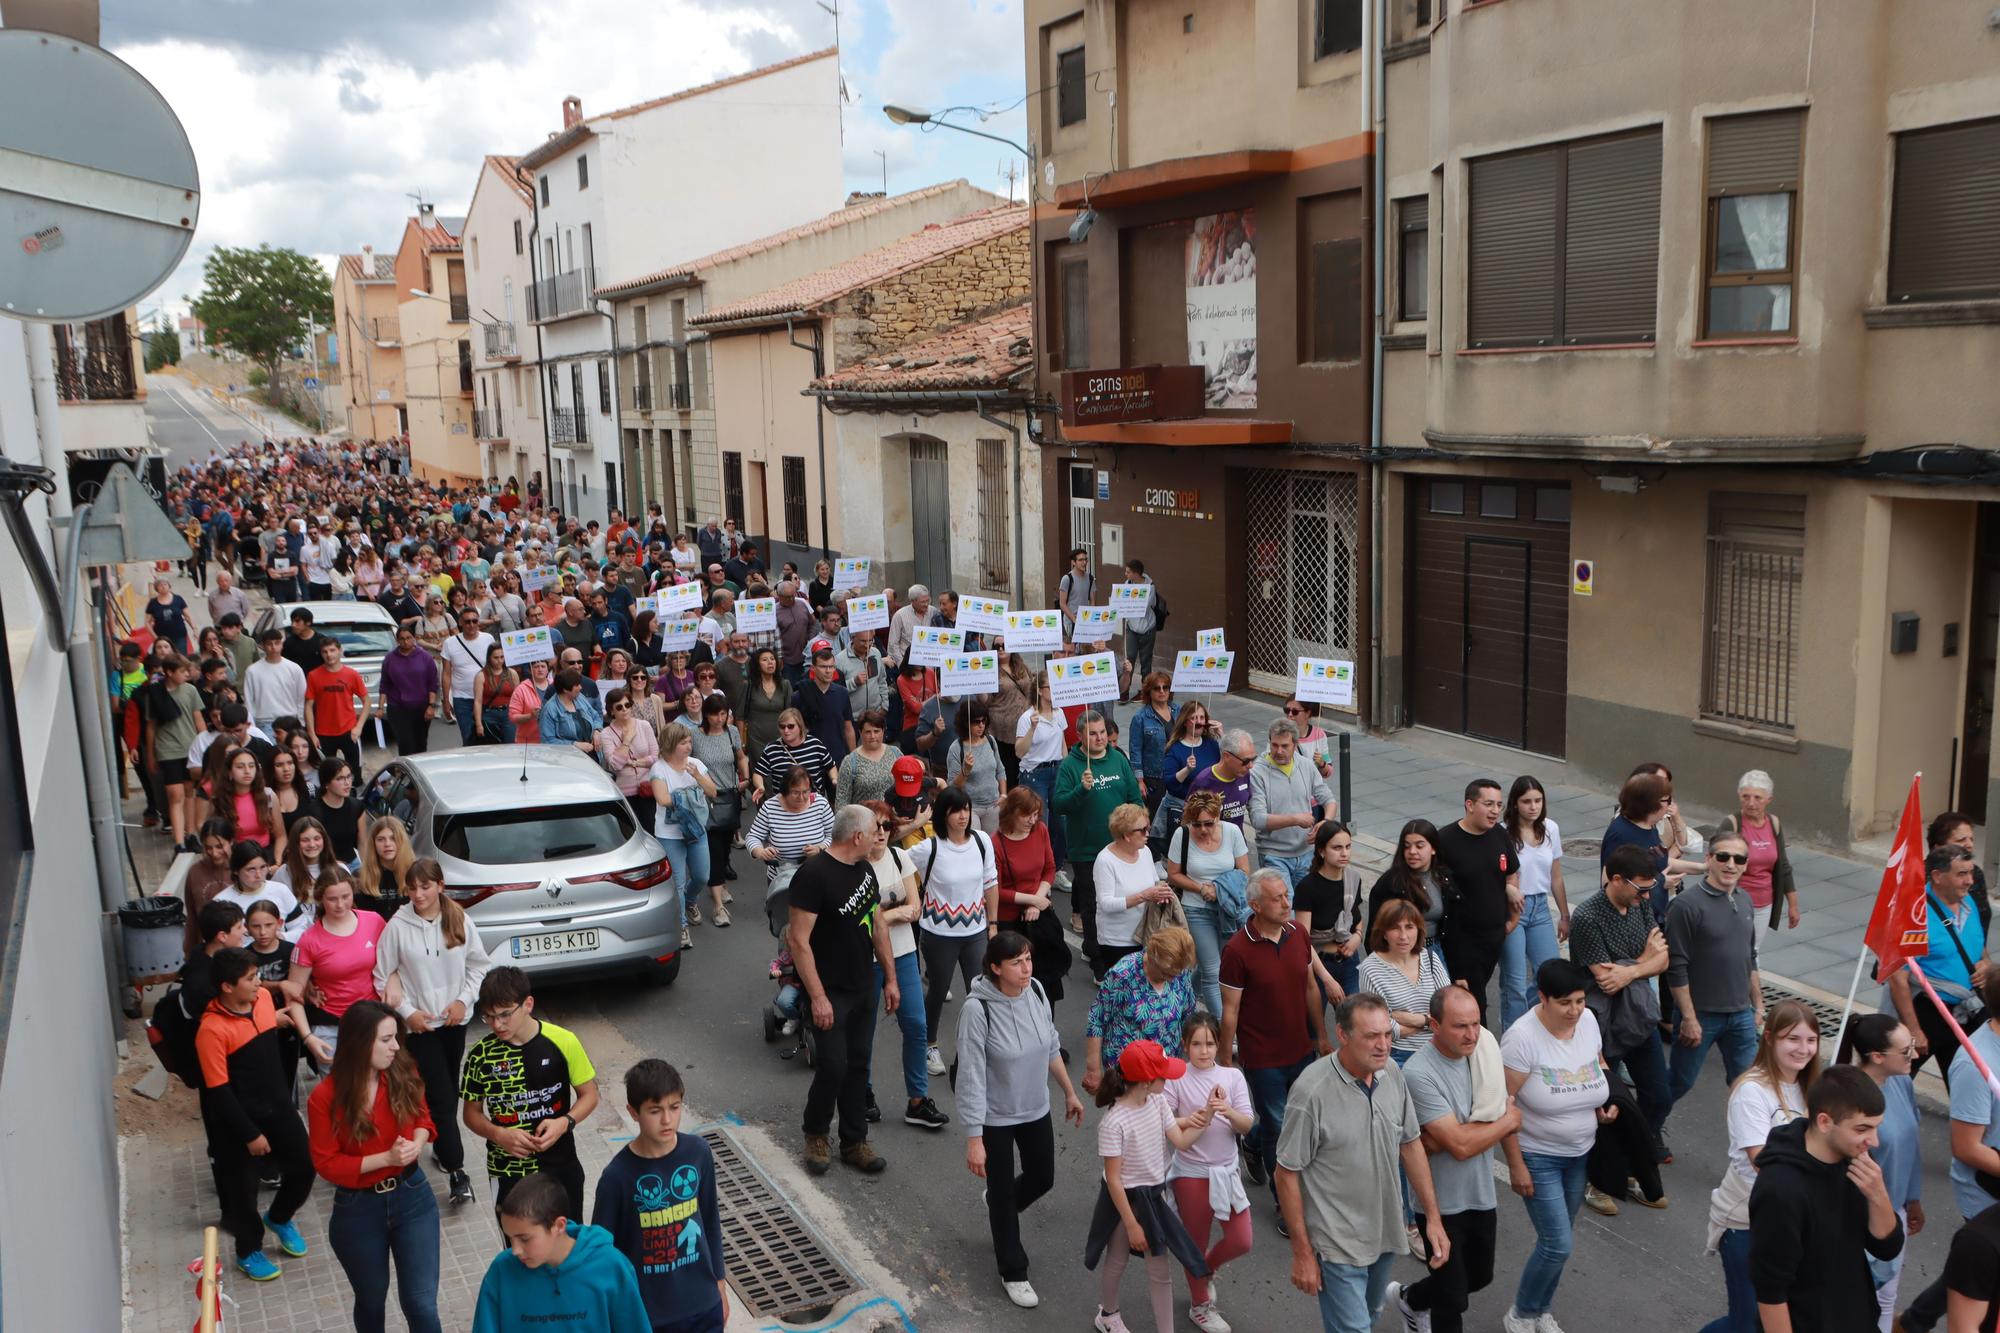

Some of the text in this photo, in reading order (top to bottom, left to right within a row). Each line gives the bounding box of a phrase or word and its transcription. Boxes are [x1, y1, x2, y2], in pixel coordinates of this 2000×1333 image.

[1089, 372, 1145, 393] carnsnoel
[1145, 487, 1199, 510] carnsnoel
[523, 935, 562, 953] 3185
[567, 931, 596, 948] KTD
[639, 1197, 698, 1228] DANGER
[643, 1265, 652, 1274] IS
[654, 1263, 670, 1273] NOT
